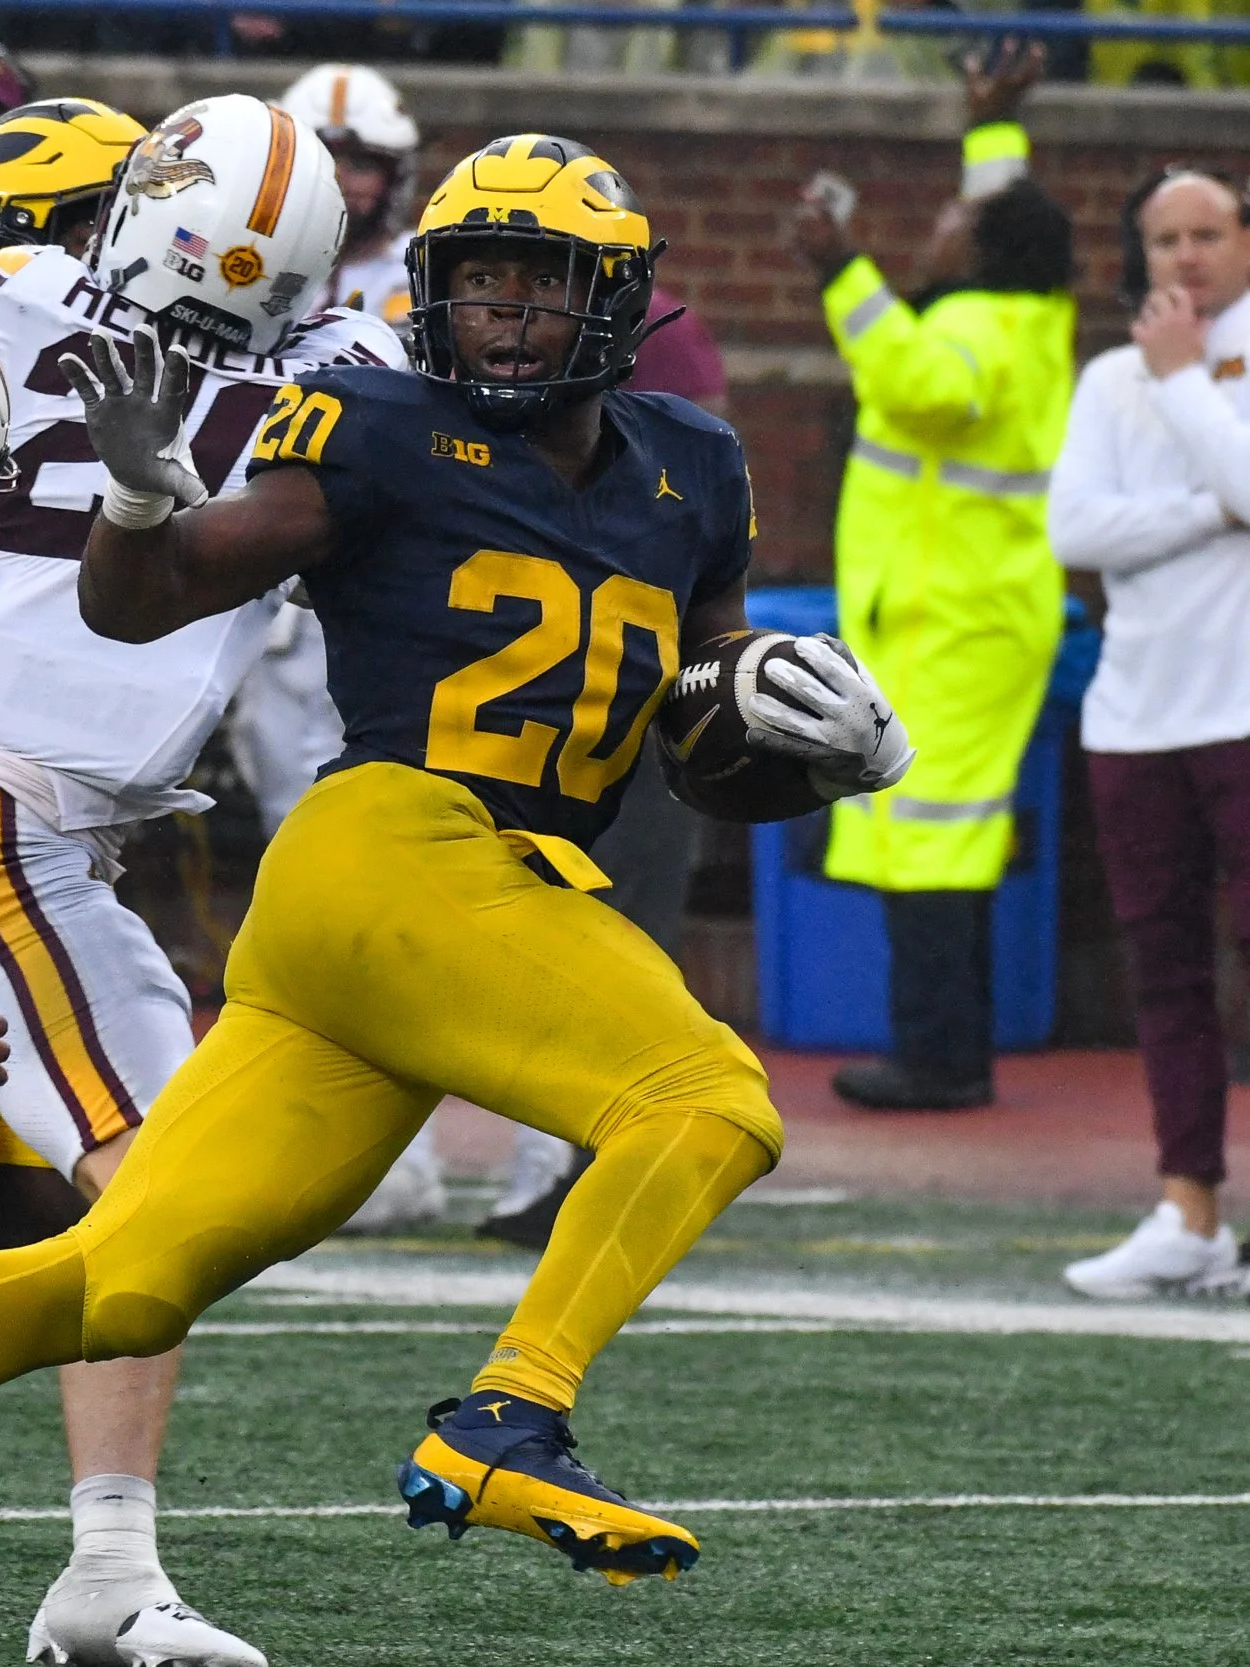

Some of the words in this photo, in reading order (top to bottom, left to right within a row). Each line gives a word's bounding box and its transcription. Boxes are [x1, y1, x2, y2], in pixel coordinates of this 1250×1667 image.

[486, 206, 511, 223] M
[229, 256, 254, 278] 20
[252, 383, 343, 465] 20
[425, 549, 680, 803] 20
